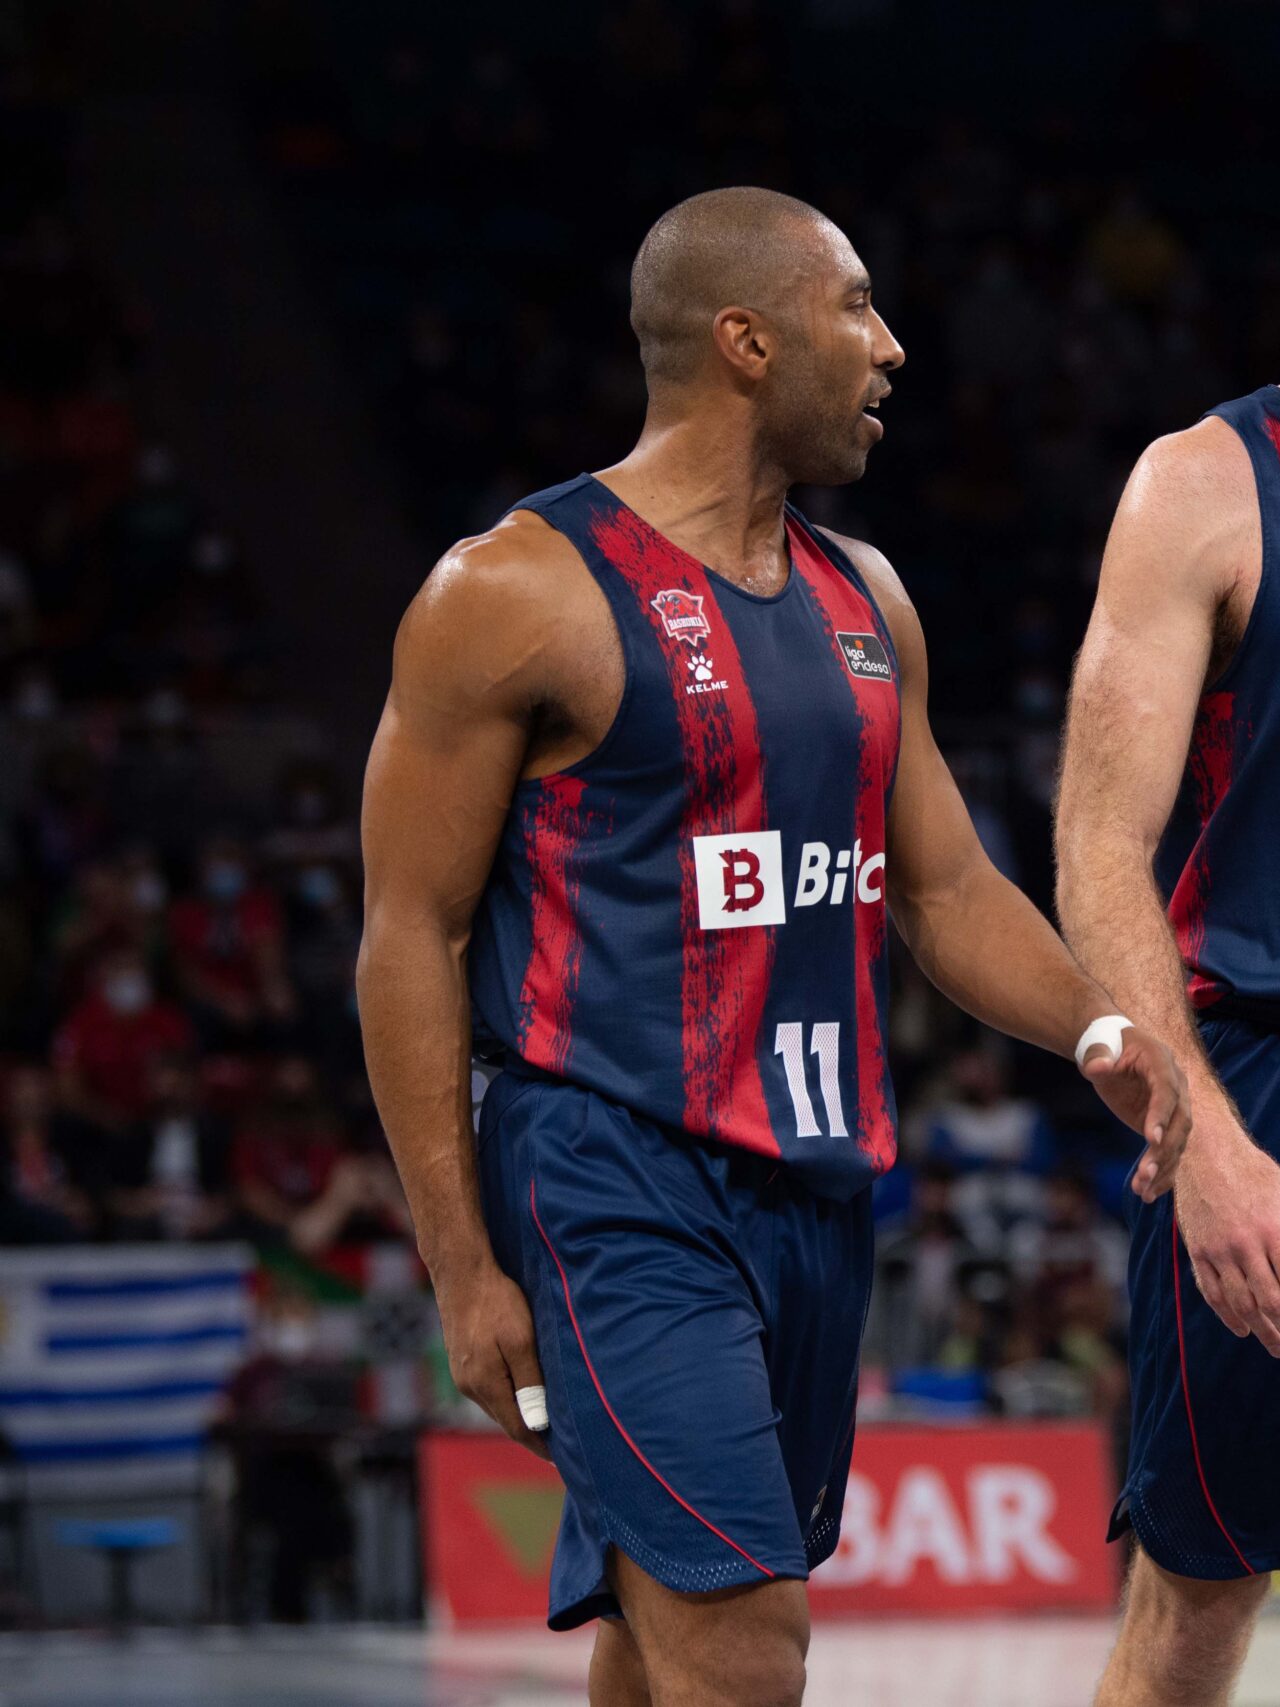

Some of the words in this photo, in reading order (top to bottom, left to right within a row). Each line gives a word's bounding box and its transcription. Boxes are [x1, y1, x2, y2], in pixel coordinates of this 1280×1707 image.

[844, 645, 866, 660] liga
[851, 659, 890, 675] endesa
[686, 680, 729, 695] KELME
[793, 837, 886, 908] Bitc
[773, 1021, 849, 1138] 11
